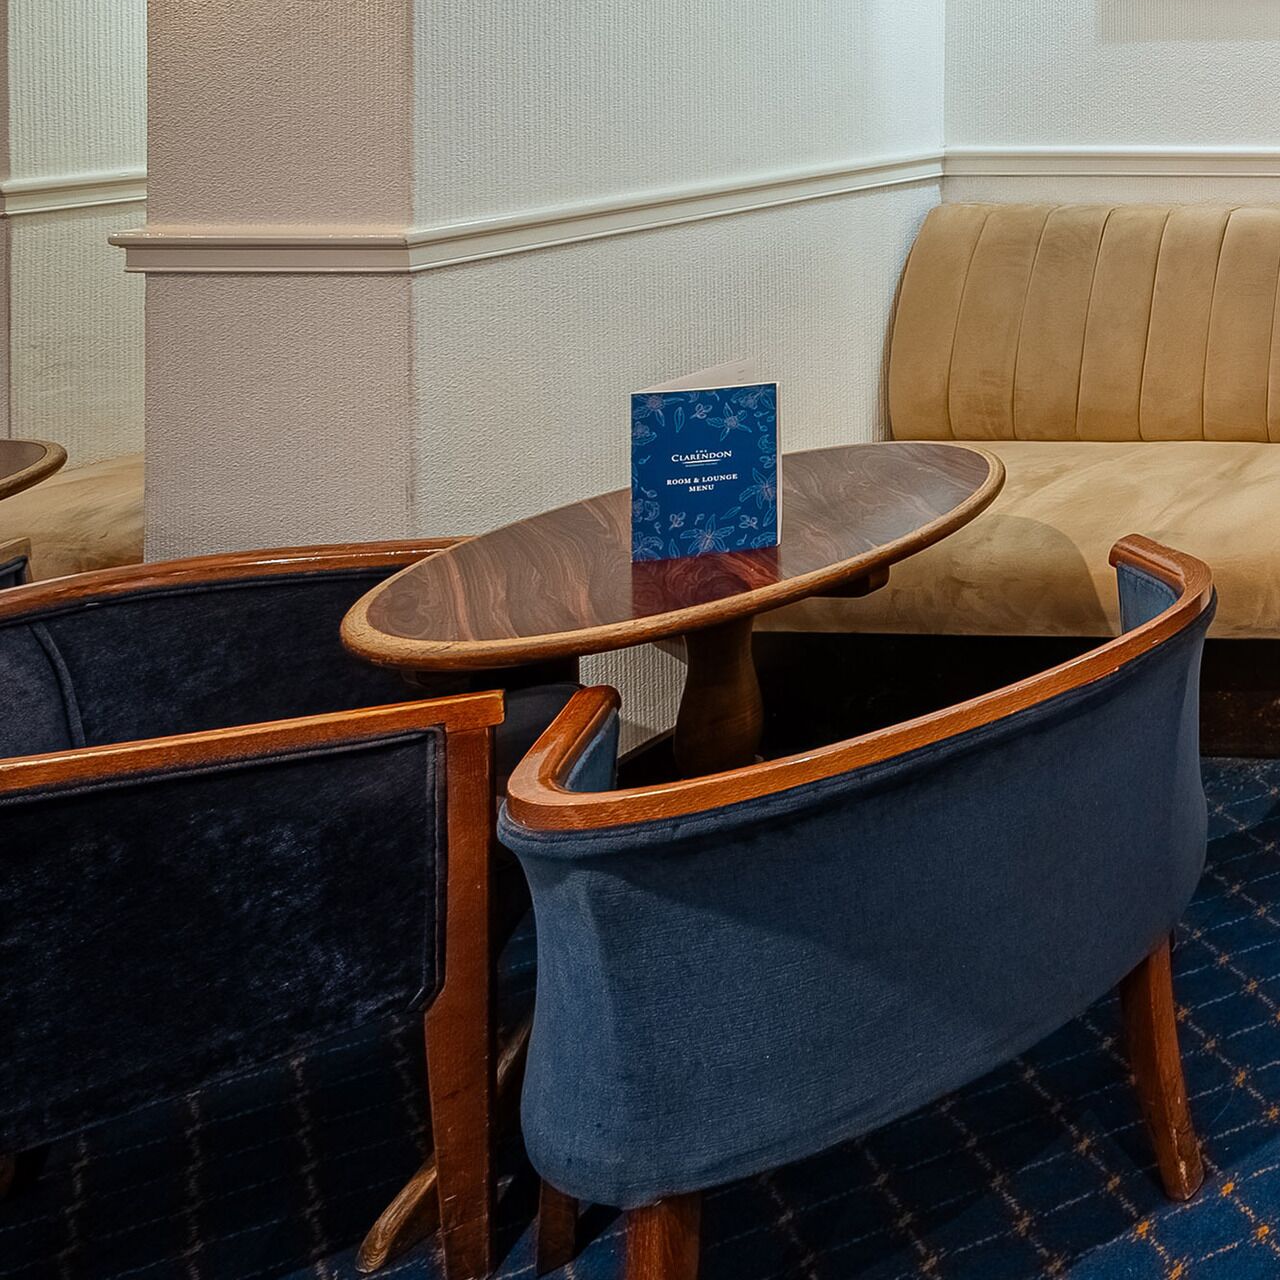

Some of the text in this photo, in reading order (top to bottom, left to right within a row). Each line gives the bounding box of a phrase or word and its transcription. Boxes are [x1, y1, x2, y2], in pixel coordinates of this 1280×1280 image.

[671, 450, 732, 462] CLARENDON
[666, 477, 691, 486] ROOM
[702, 473, 738, 483] LOUNGE
[688, 484, 714, 493] MENU
